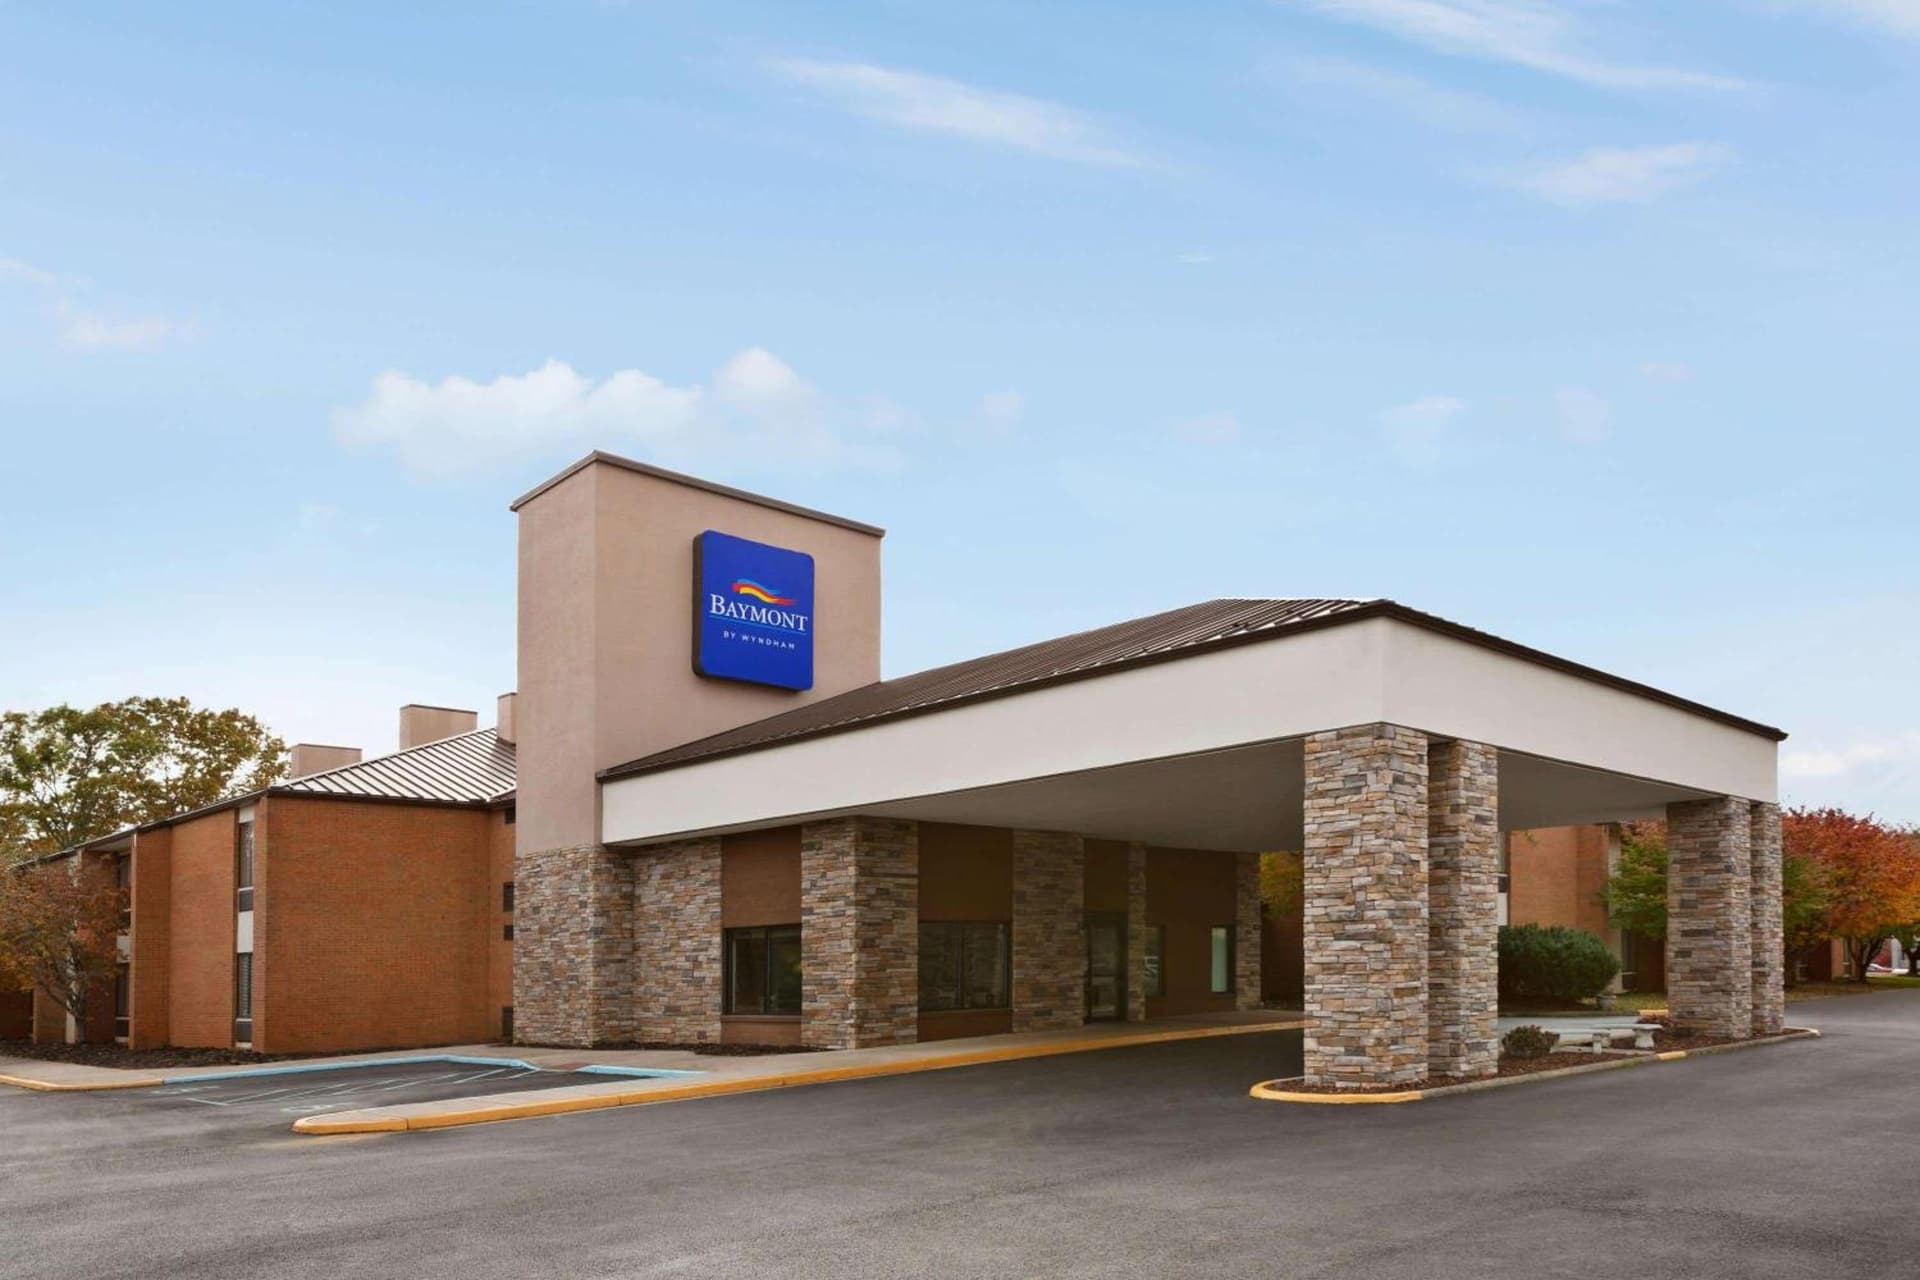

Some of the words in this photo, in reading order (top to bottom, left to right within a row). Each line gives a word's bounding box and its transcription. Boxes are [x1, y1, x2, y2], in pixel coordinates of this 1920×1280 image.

[710, 593, 808, 631] BAYMONT
[723, 630, 736, 639] BY
[741, 633, 795, 649] WYNDHAM
